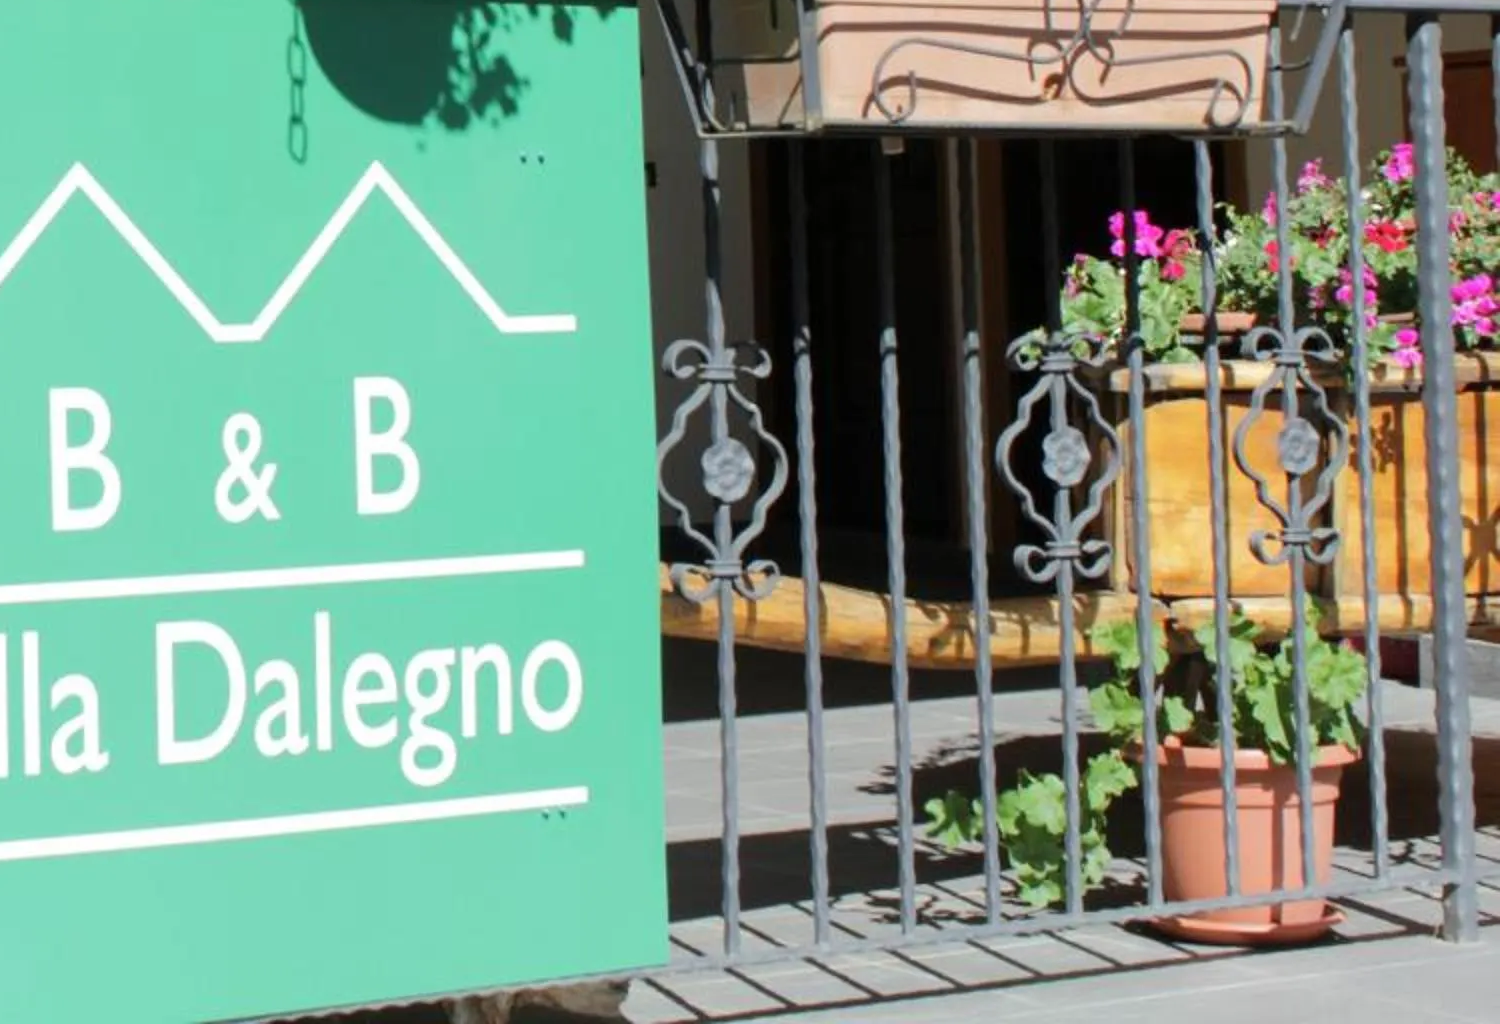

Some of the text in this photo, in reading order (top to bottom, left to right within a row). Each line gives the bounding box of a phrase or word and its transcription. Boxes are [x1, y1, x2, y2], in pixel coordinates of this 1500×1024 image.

[48, 375, 421, 533] B & B
[154, 610, 585, 788] Dalegno
